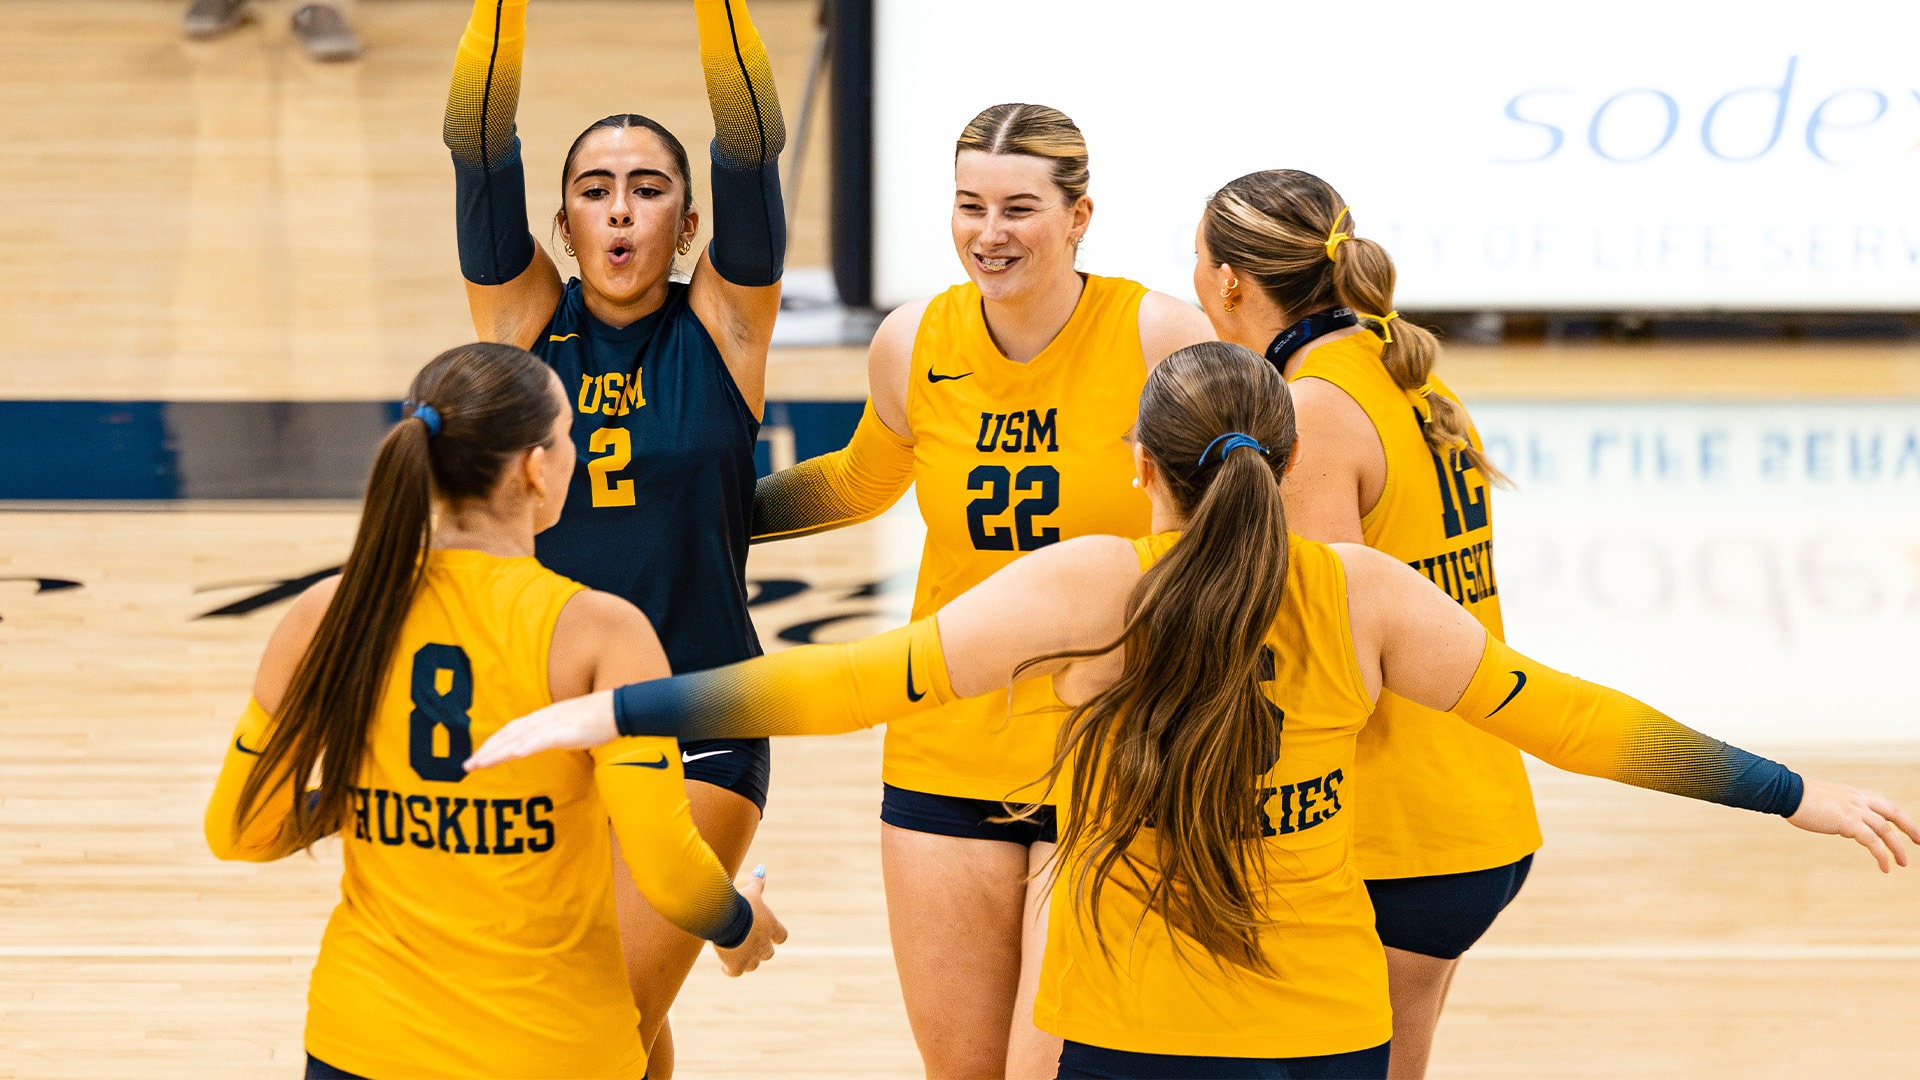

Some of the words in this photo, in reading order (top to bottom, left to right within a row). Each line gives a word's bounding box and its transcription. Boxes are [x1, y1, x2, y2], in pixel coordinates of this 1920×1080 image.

[1485, 54, 1920, 169] sode
[1481, 223, 1559, 270] OF
[1591, 223, 1732, 270] LIFE
[578, 367, 646, 416] USM
[976, 408, 1059, 452] USM
[587, 427, 636, 508] 2
[966, 465, 1060, 551] 22
[409, 642, 473, 782] 8
[354, 788, 555, 855] HUSKIES
[1256, 768, 1344, 838] KIES
